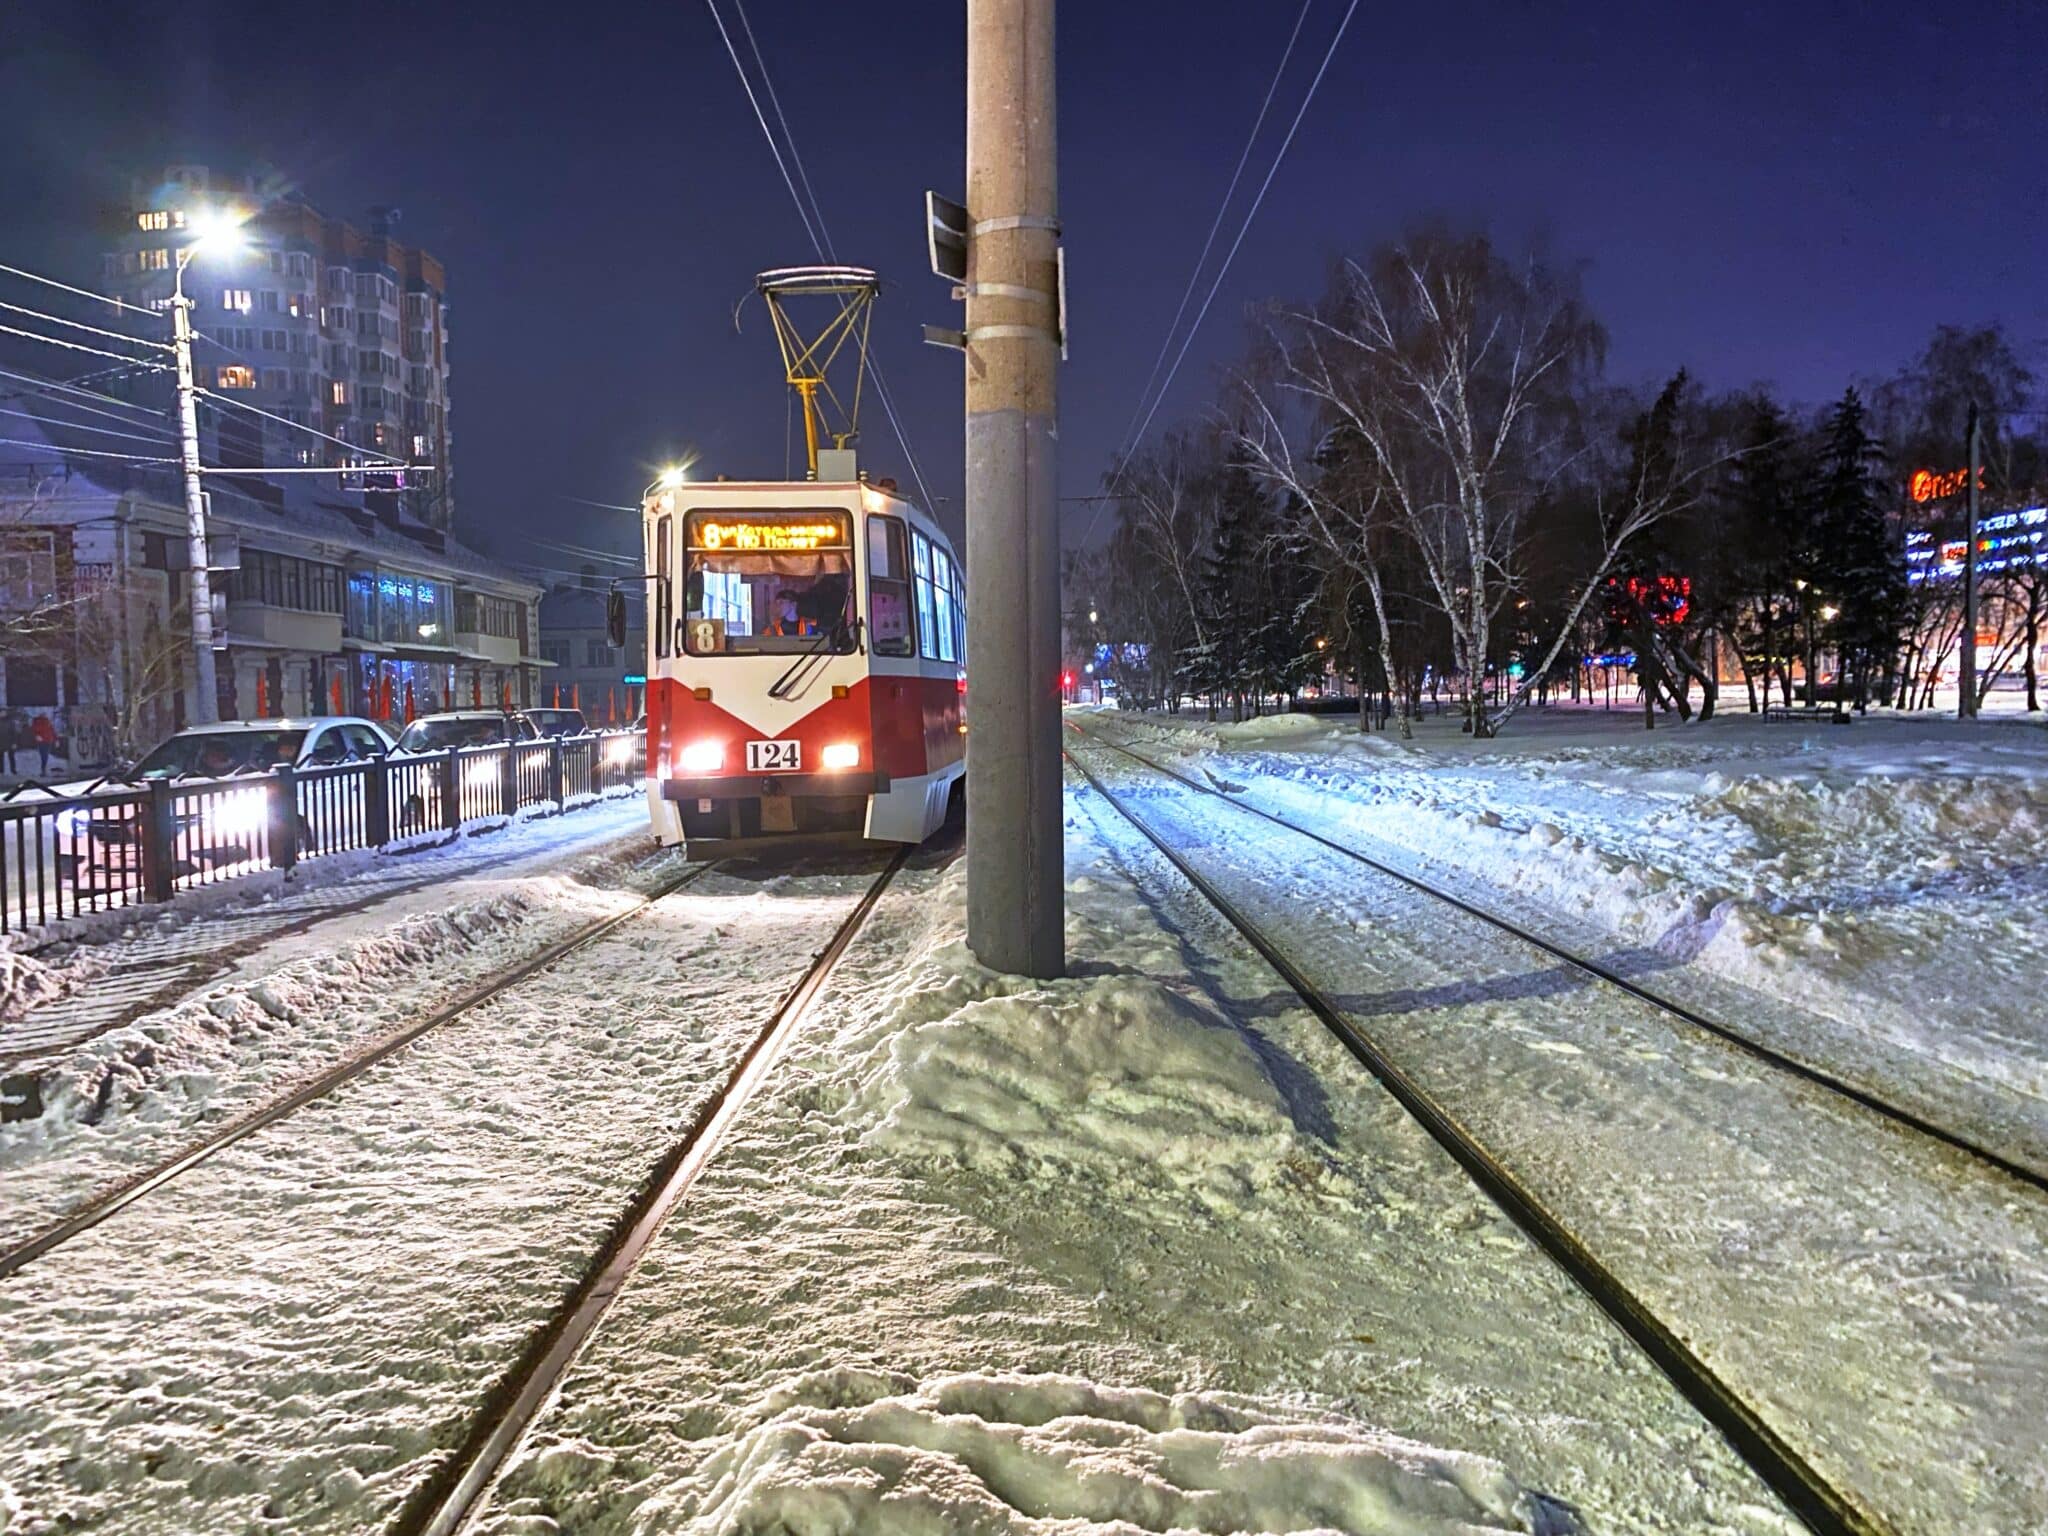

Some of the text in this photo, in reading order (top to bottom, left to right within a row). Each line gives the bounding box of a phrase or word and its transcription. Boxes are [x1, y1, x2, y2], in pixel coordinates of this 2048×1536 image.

[704, 523, 720, 548] 8
[696, 623, 715, 653] 8
[749, 743, 799, 769] 124
